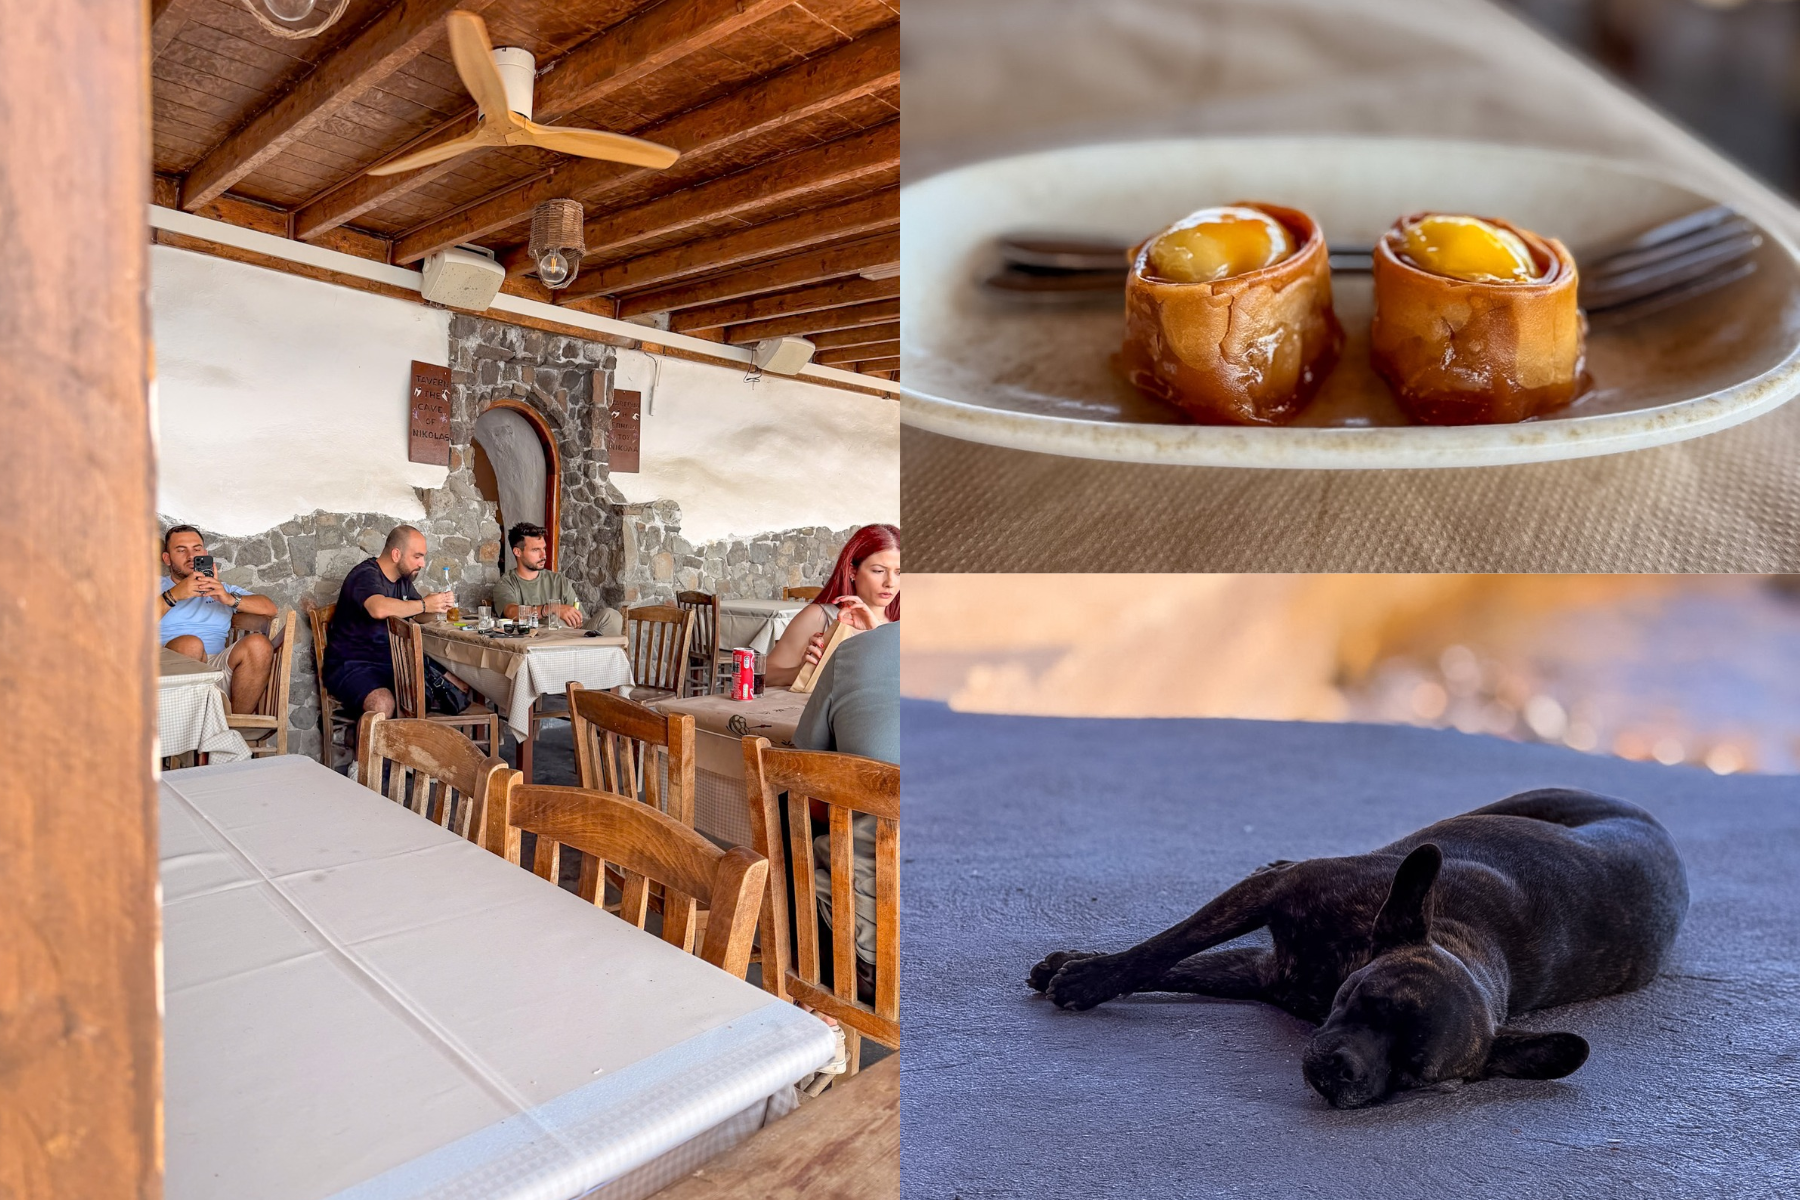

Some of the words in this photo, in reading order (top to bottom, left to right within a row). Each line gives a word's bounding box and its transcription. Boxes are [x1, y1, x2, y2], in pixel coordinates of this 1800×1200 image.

[424, 391, 441, 400] THE
[418, 403, 443, 413] CAVE
[412, 429, 450, 441] NIKOLAS
